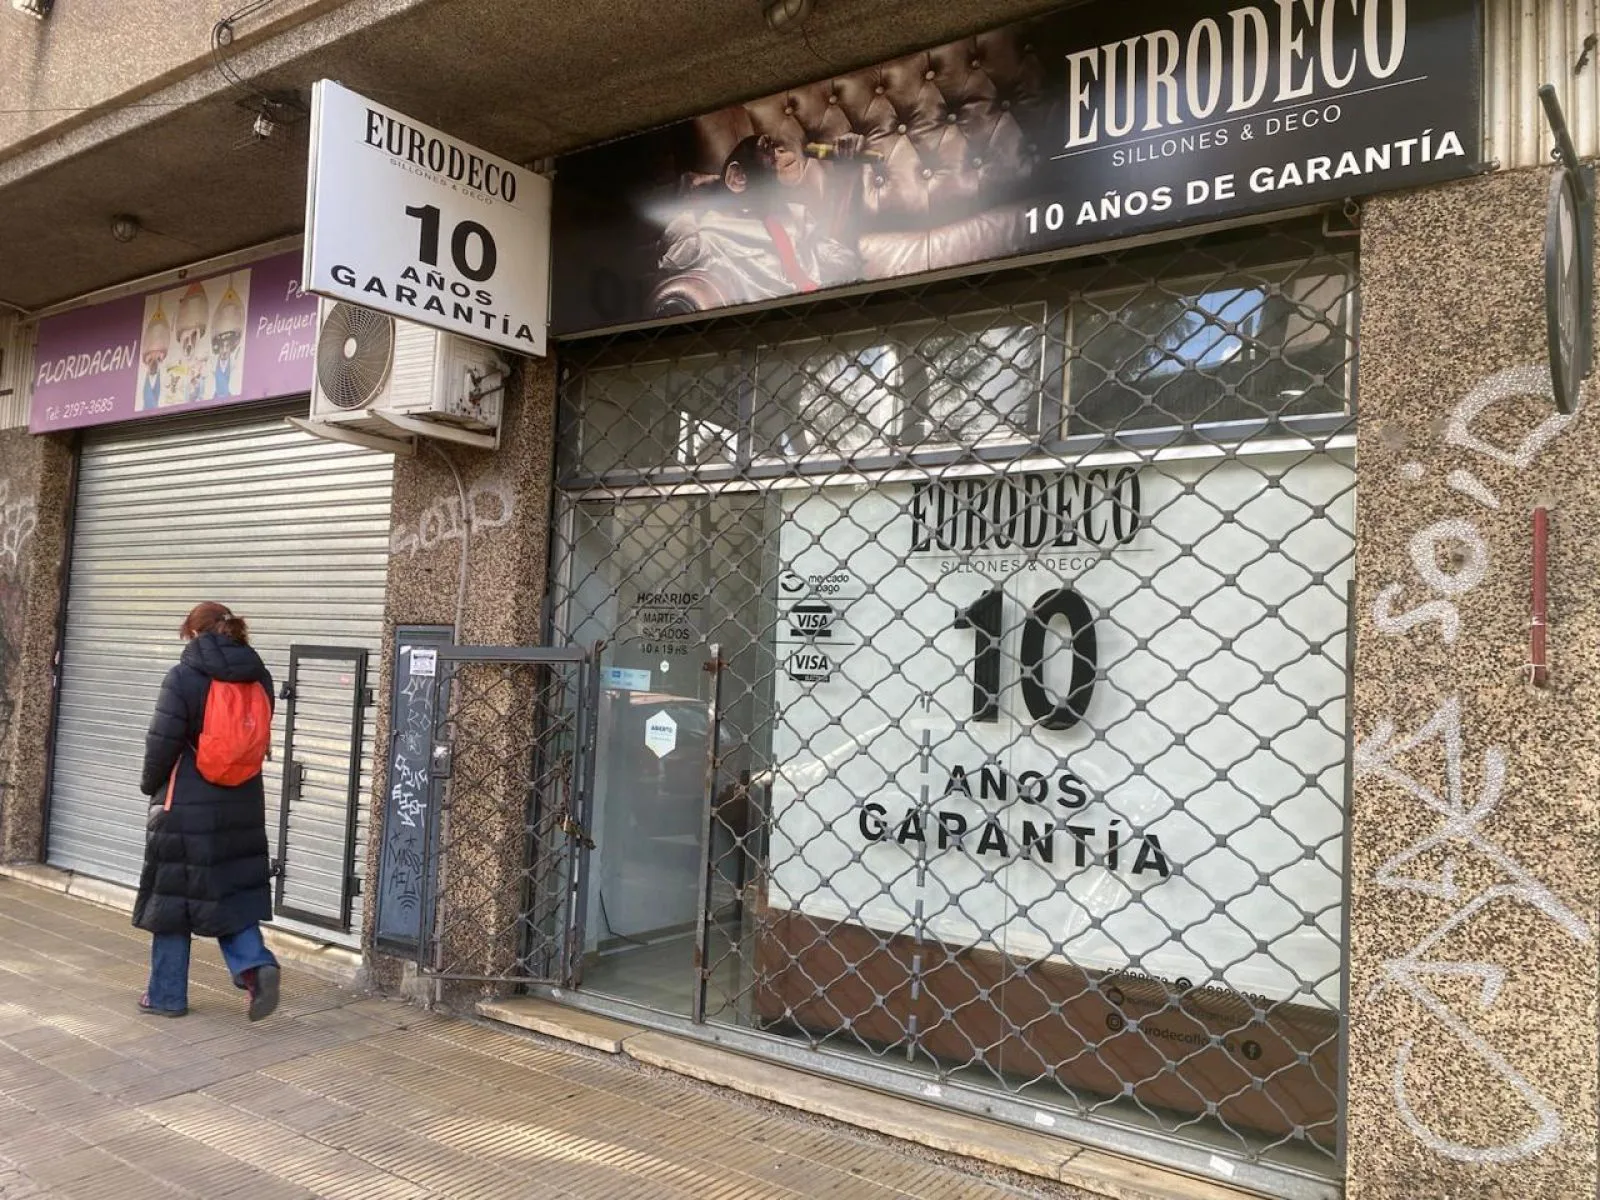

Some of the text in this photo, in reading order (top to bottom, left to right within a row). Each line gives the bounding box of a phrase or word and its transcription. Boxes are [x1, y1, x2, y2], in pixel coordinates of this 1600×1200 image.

[1064, 0, 1407, 149] EURODECO
[364, 108, 516, 203] EURODECO
[1112, 105, 1342, 167] SILLONES & DECO
[390, 158, 447, 186] SILLONES
[462, 188, 493, 205] DECO
[1025, 128, 1466, 234] 10 AÑOS DE GARANTÍA
[405, 203, 497, 282] 10
[330, 264, 535, 343] GARANTÍA
[400, 266, 493, 306] AÑOS
[36, 340, 137, 387] FLORIDACAN
[63, 396, 115, 418] 2197-3685
[911, 466, 1141, 552] EURODECO
[940, 559, 1021, 573] SILLONES
[1045, 557, 1097, 571] DECO
[641, 643, 652, 654] 10
[663, 644, 673, 655] 19
[797, 614, 828, 629] VISA
[794, 655, 829, 670] VISA
[954, 588, 1098, 731] 10
[944, 760, 1087, 808] AÑOS
[859, 803, 1170, 877] GARANTÍA
